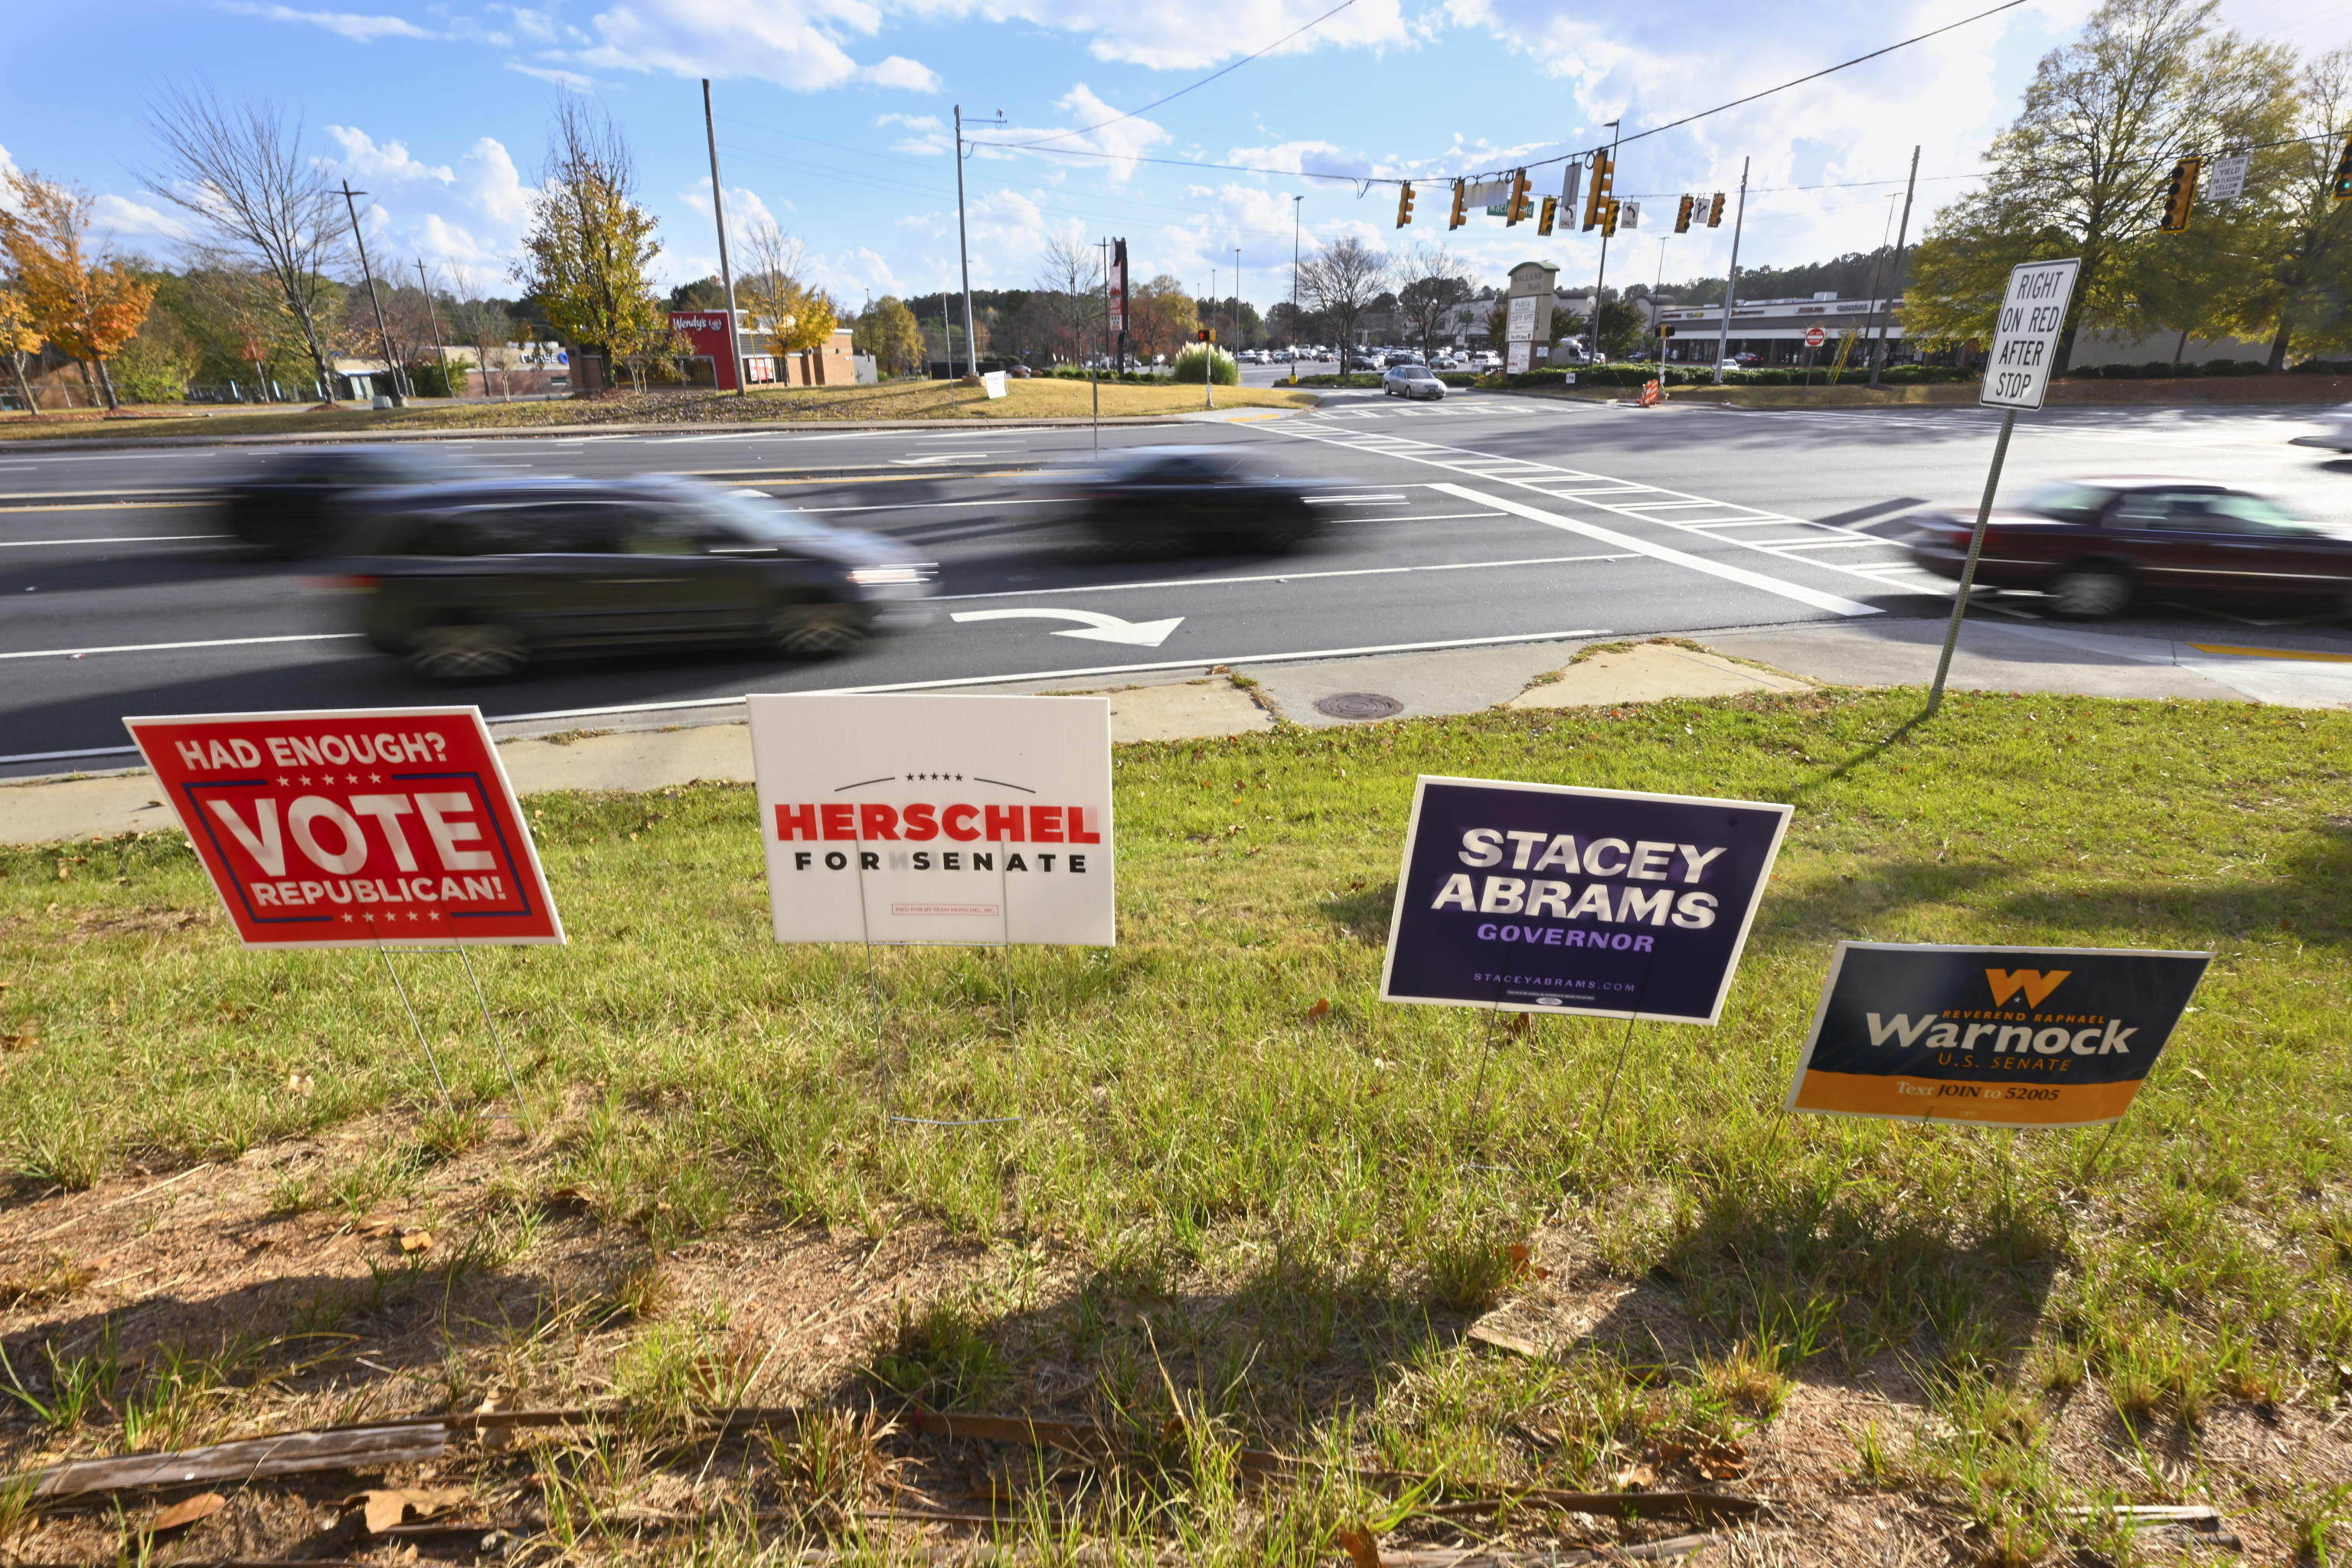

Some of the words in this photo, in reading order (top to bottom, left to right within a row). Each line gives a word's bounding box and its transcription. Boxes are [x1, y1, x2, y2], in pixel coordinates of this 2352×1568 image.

[2220, 167, 2240, 175] YIELD
[2017, 271, 2063, 299] RIGHT
[673, 315, 707, 331] Wendy's
[2002, 308, 2024, 333] ON
[2028, 306, 2060, 333] RED
[1999, 340, 2044, 366] AFTER
[1996, 372, 2031, 398] STOP
[175, 738, 262, 770] HAD
[265, 731, 446, 767] ENOUGH?
[207, 792, 497, 877] VOTE
[774, 803, 1100, 844] HERSCHEL
[795, 851, 880, 871] FOR
[912, 851, 1086, 874] SENATE
[1458, 828, 1728, 884] STACEY
[250, 876, 506, 906] REPUBLICAN!
[1430, 873, 1720, 929] ABRAMS
[1476, 923, 1655, 953] GOVERNOR
[1474, 973, 1635, 992] STACEYABRAMS.COM
[1942, 1011, 2026, 1022] REVEREND
[2034, 1014, 2105, 1024] RAPHAEL
[1866, 1012, 2139, 1055] Warnock
[1938, 1053, 1979, 1068] U.S.
[1991, 1056, 2072, 1072] SENATE
[1896, 1081, 1936, 1096] Text
[1936, 1083, 1982, 1098] JOIN
[1983, 1088, 2002, 1099] to
[2004, 1087, 2061, 1101] 52005
